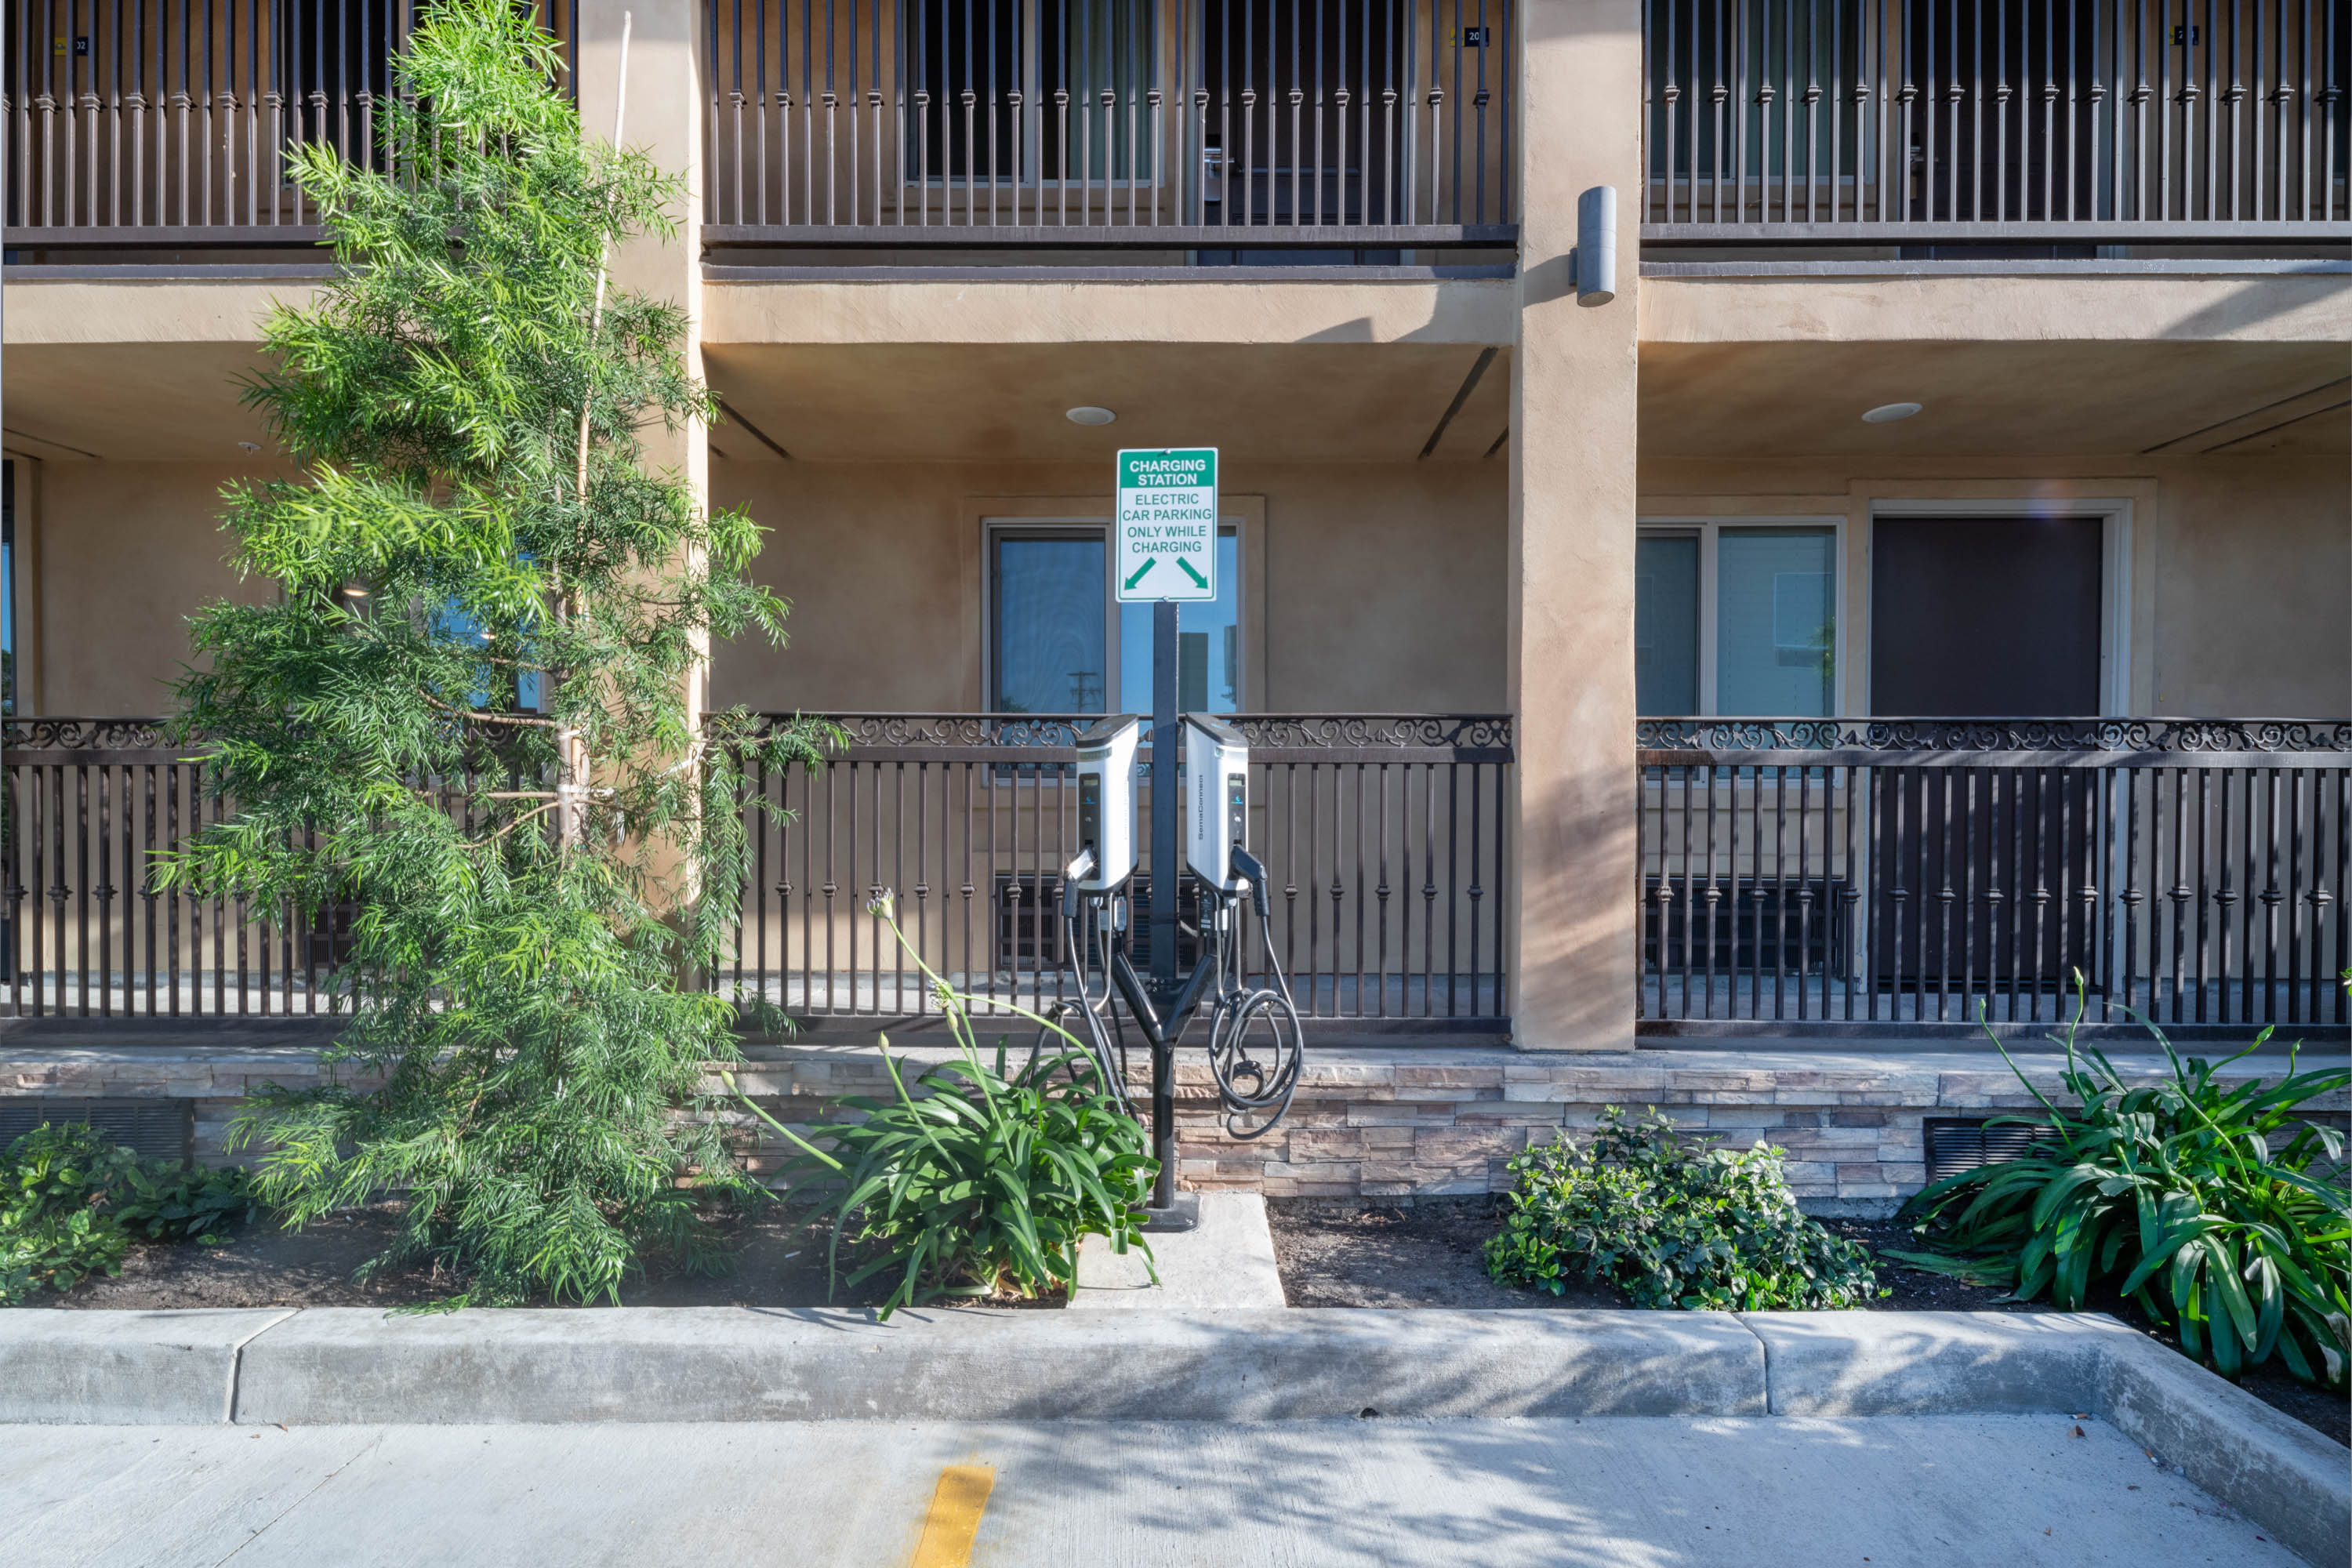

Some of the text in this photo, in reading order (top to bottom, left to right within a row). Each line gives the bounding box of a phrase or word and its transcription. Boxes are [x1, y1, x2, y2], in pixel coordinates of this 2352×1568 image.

[1469, 32, 1480, 41] 20
[1130, 459, 1206, 473] CHARGING
[1138, 474, 1197, 486] STATION
[1135, 493, 1199, 505] ELECTRIC
[1123, 509, 1211, 521] CAR PARKING
[1127, 525, 1207, 538] ONLY WHILE
[1132, 541, 1202, 553] CHARGING
